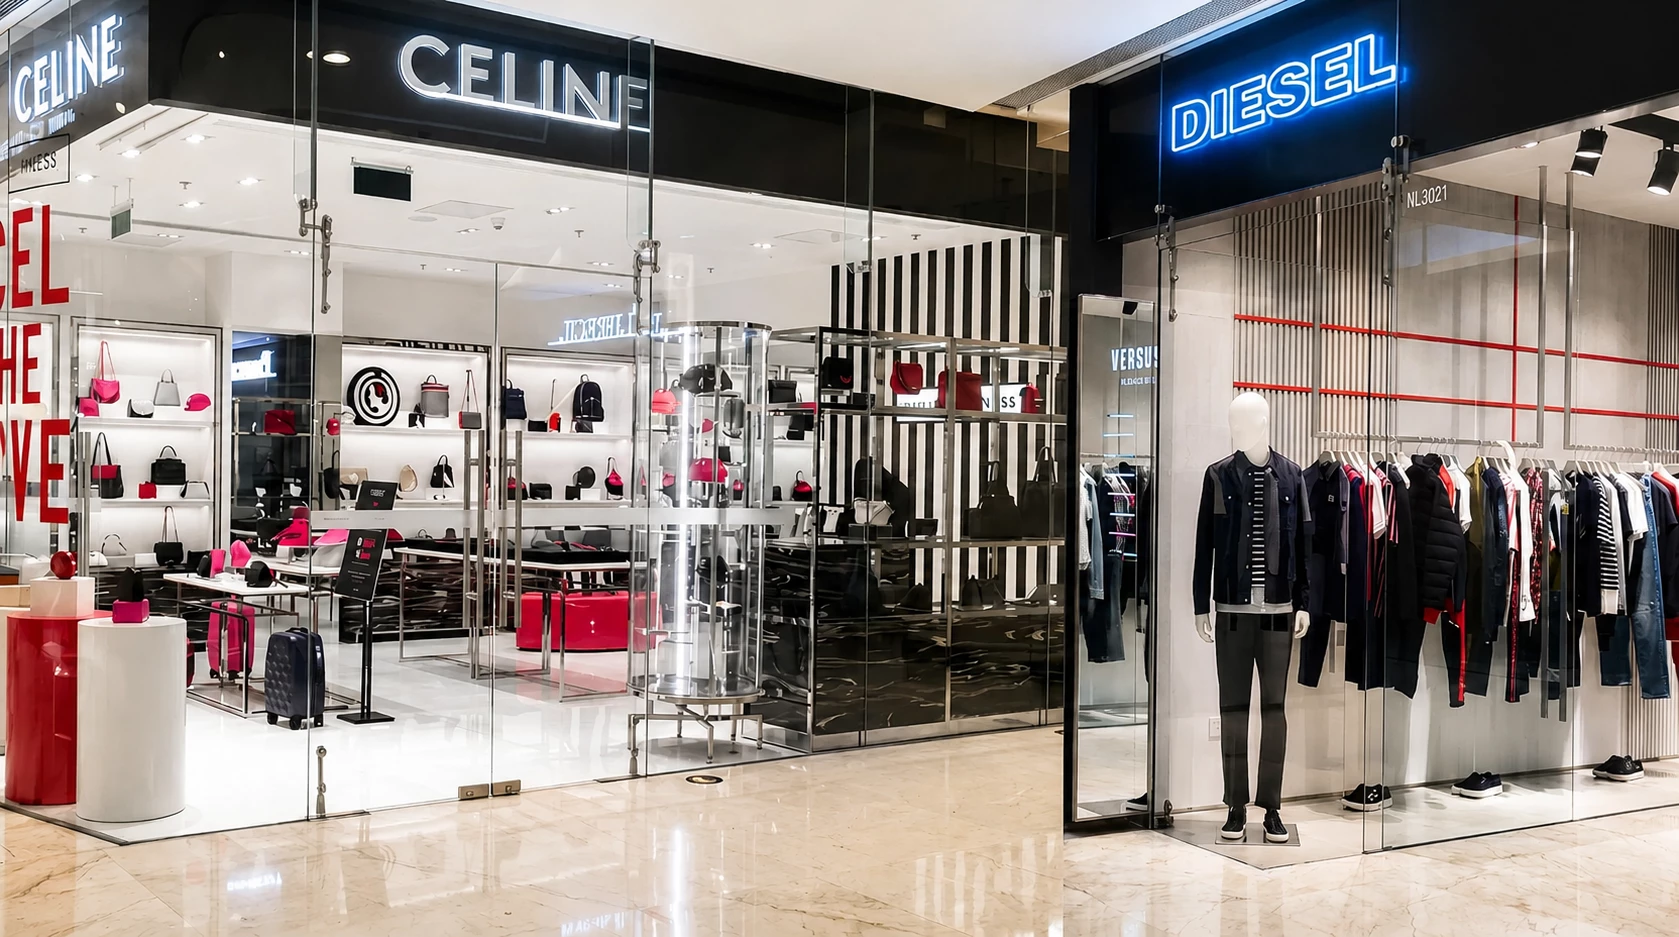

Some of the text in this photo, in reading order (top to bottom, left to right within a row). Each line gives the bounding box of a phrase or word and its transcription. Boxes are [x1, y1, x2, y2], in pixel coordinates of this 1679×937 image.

[14, 14, 124, 123] CELINE
[398, 34, 651, 131] CELINE
[1171, 33, 1398, 153] DIESEL
[1407, 184, 1447, 209] NL3021
[0, 204, 70, 310] EL
[0, 419, 70, 524] VE
